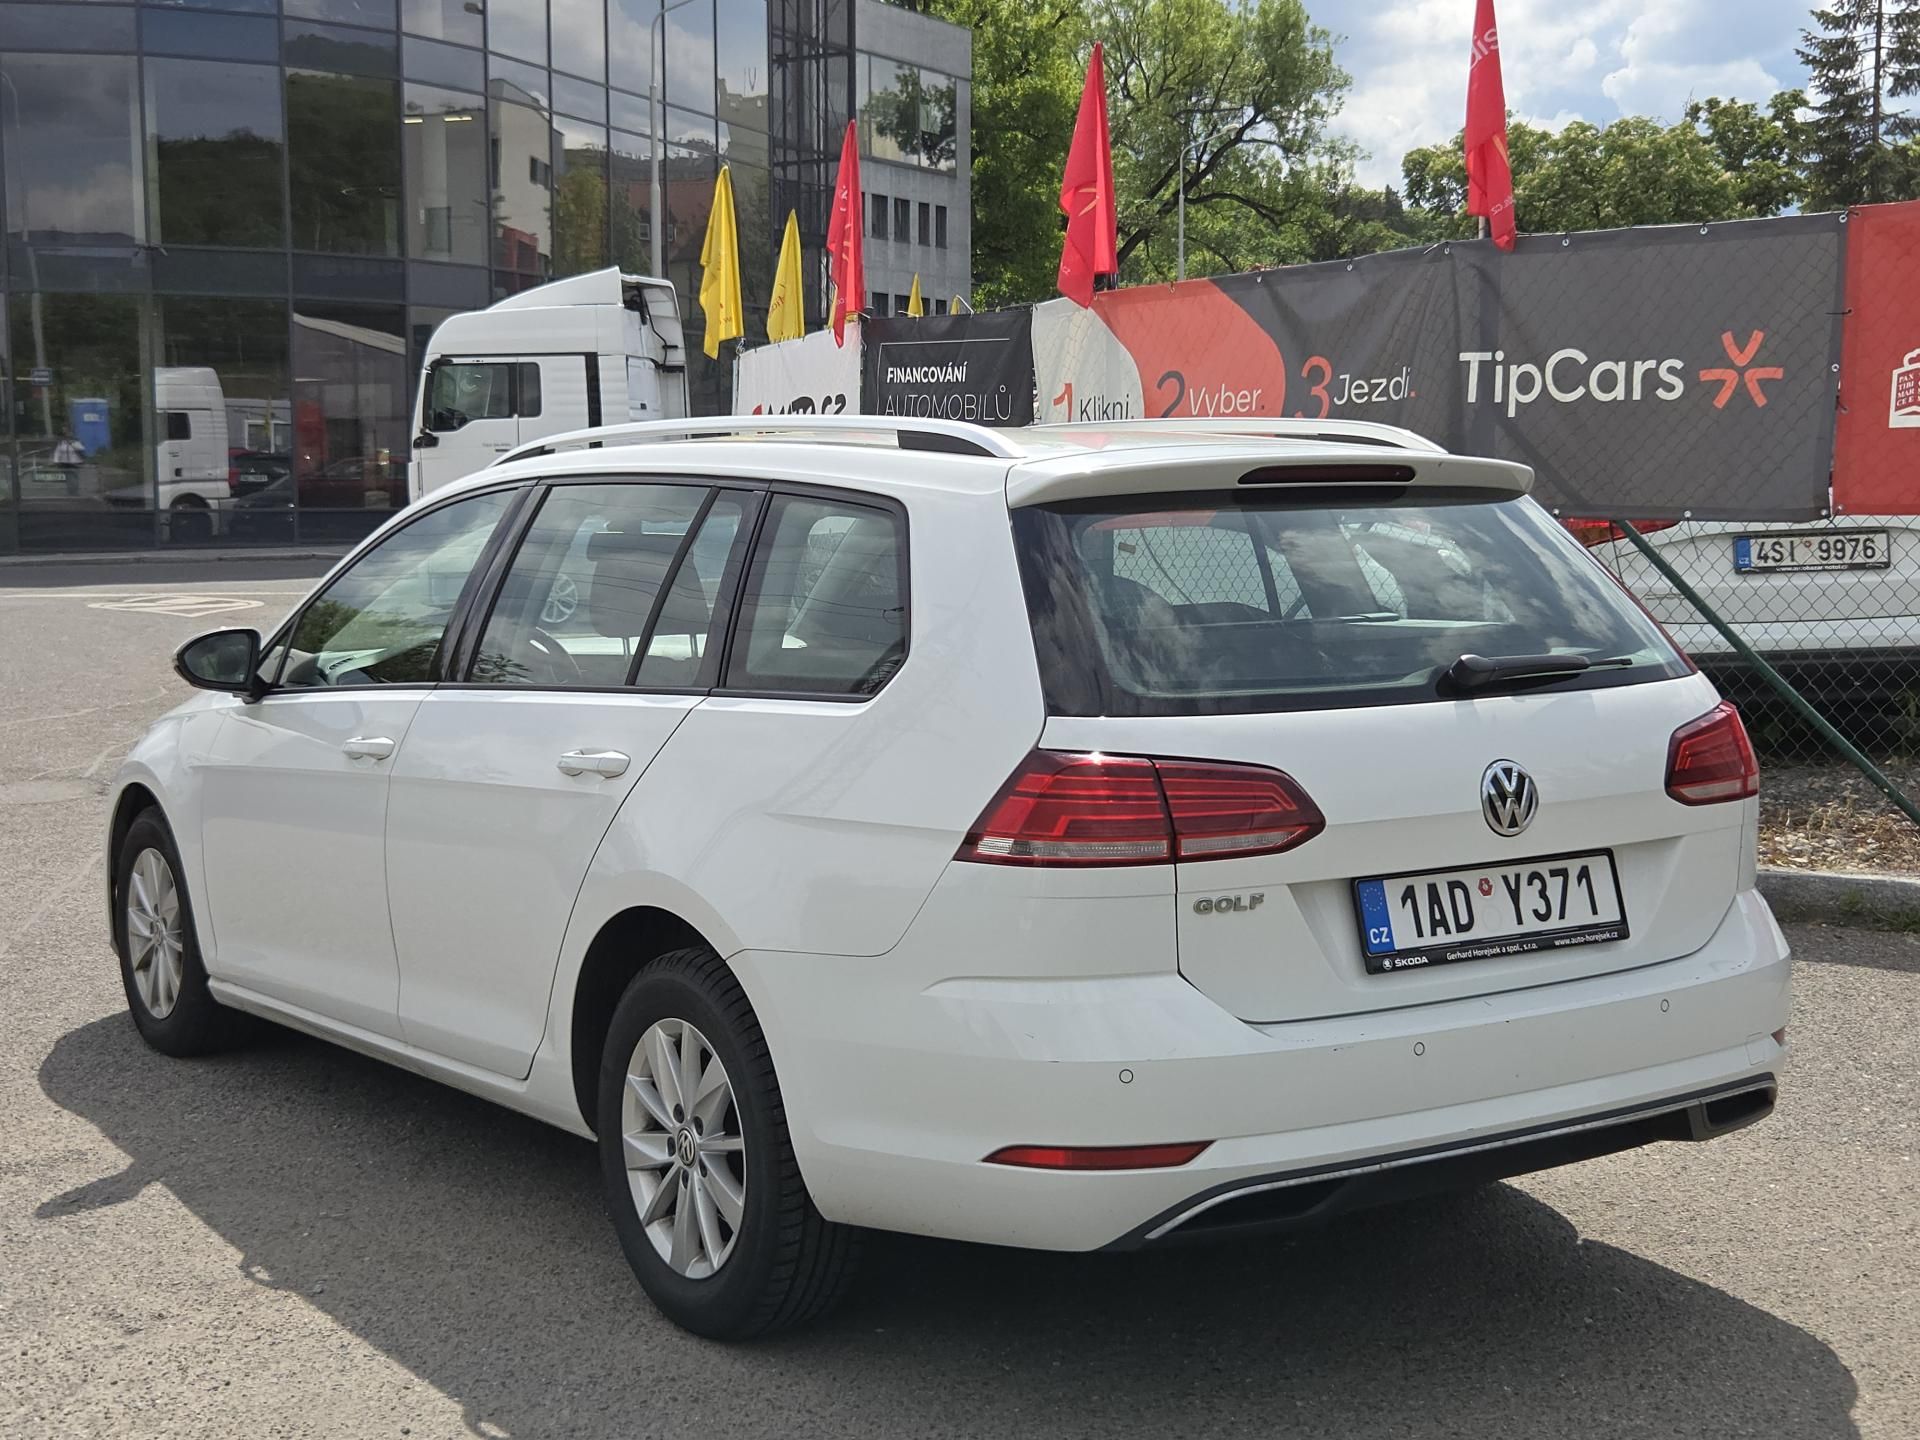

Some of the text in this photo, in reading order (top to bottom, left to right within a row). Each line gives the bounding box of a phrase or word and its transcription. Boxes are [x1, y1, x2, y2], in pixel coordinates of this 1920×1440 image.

[886, 361, 968, 384] FINANCOVÁNÍ
[1459, 347, 1685, 418] TipCars
[885, 385, 1012, 421] AUTOMOBILŮ
[1818, 537, 1877, 562] 9976
[1193, 892, 1265, 915] GOLF
[1370, 865, 1599, 945] CZ 1AD Y371
[1446, 948, 1473, 961] Gerhard
[1523, 942, 1538, 951] s.r.o.
[1554, 931, 1619, 947] www.auto-horejsek.cz
